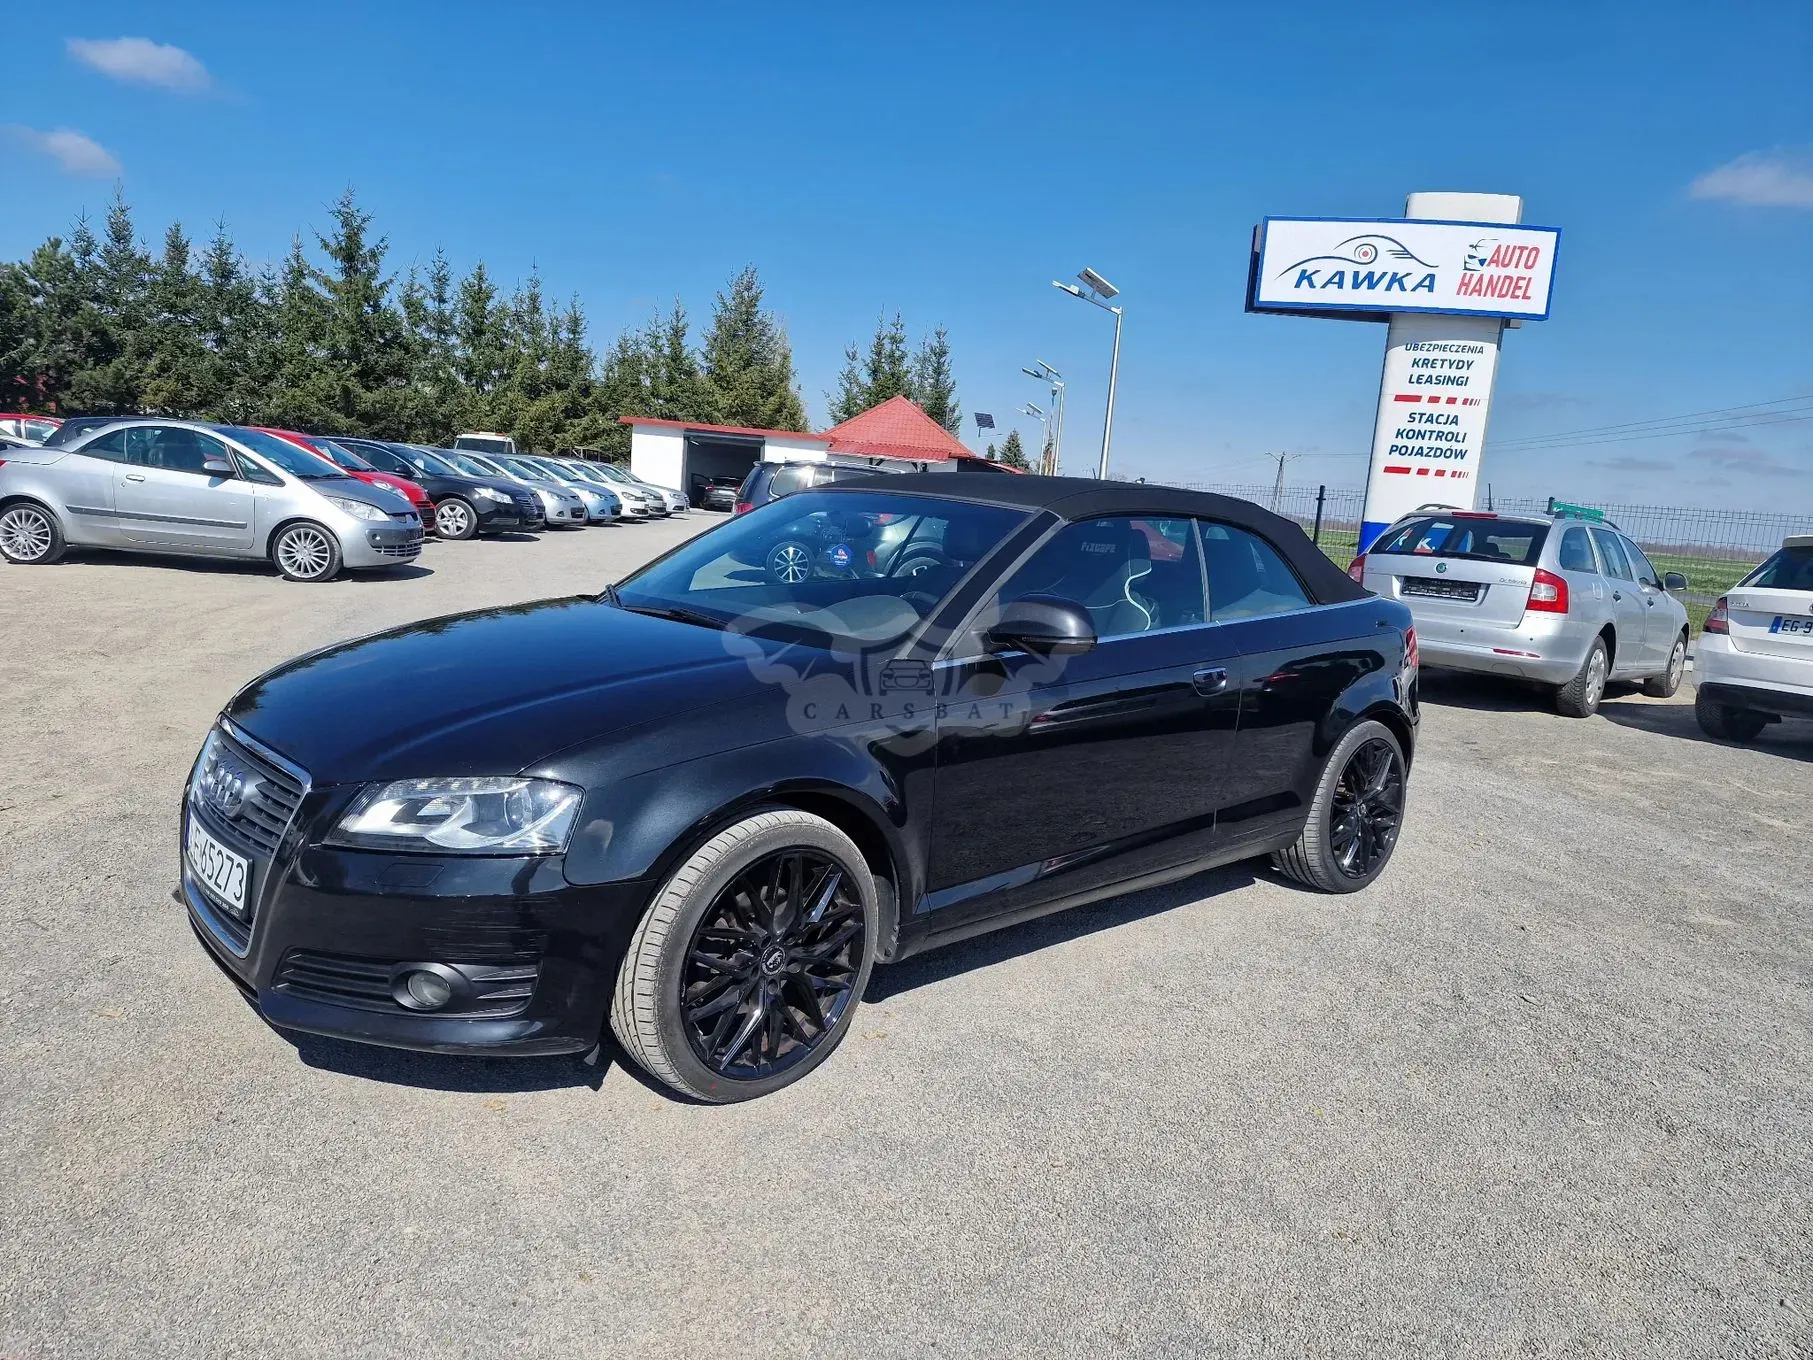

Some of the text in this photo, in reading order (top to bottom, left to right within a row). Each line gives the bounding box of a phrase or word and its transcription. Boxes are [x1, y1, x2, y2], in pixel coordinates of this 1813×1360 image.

[1486, 244, 1540, 270] AUTO
[1294, 269, 1436, 293] KAWKA
[1456, 272, 1532, 300] HANDEL
[1405, 342, 1484, 354] UBEZPIECZENIA
[1411, 357, 1474, 371] KRETYDY
[1408, 373, 1469, 387] LEASINGI
[1407, 412, 1459, 426] STACJA
[1395, 428, 1467, 444] KONTROLI
[1388, 444, 1468, 460] POJAZDÓW
